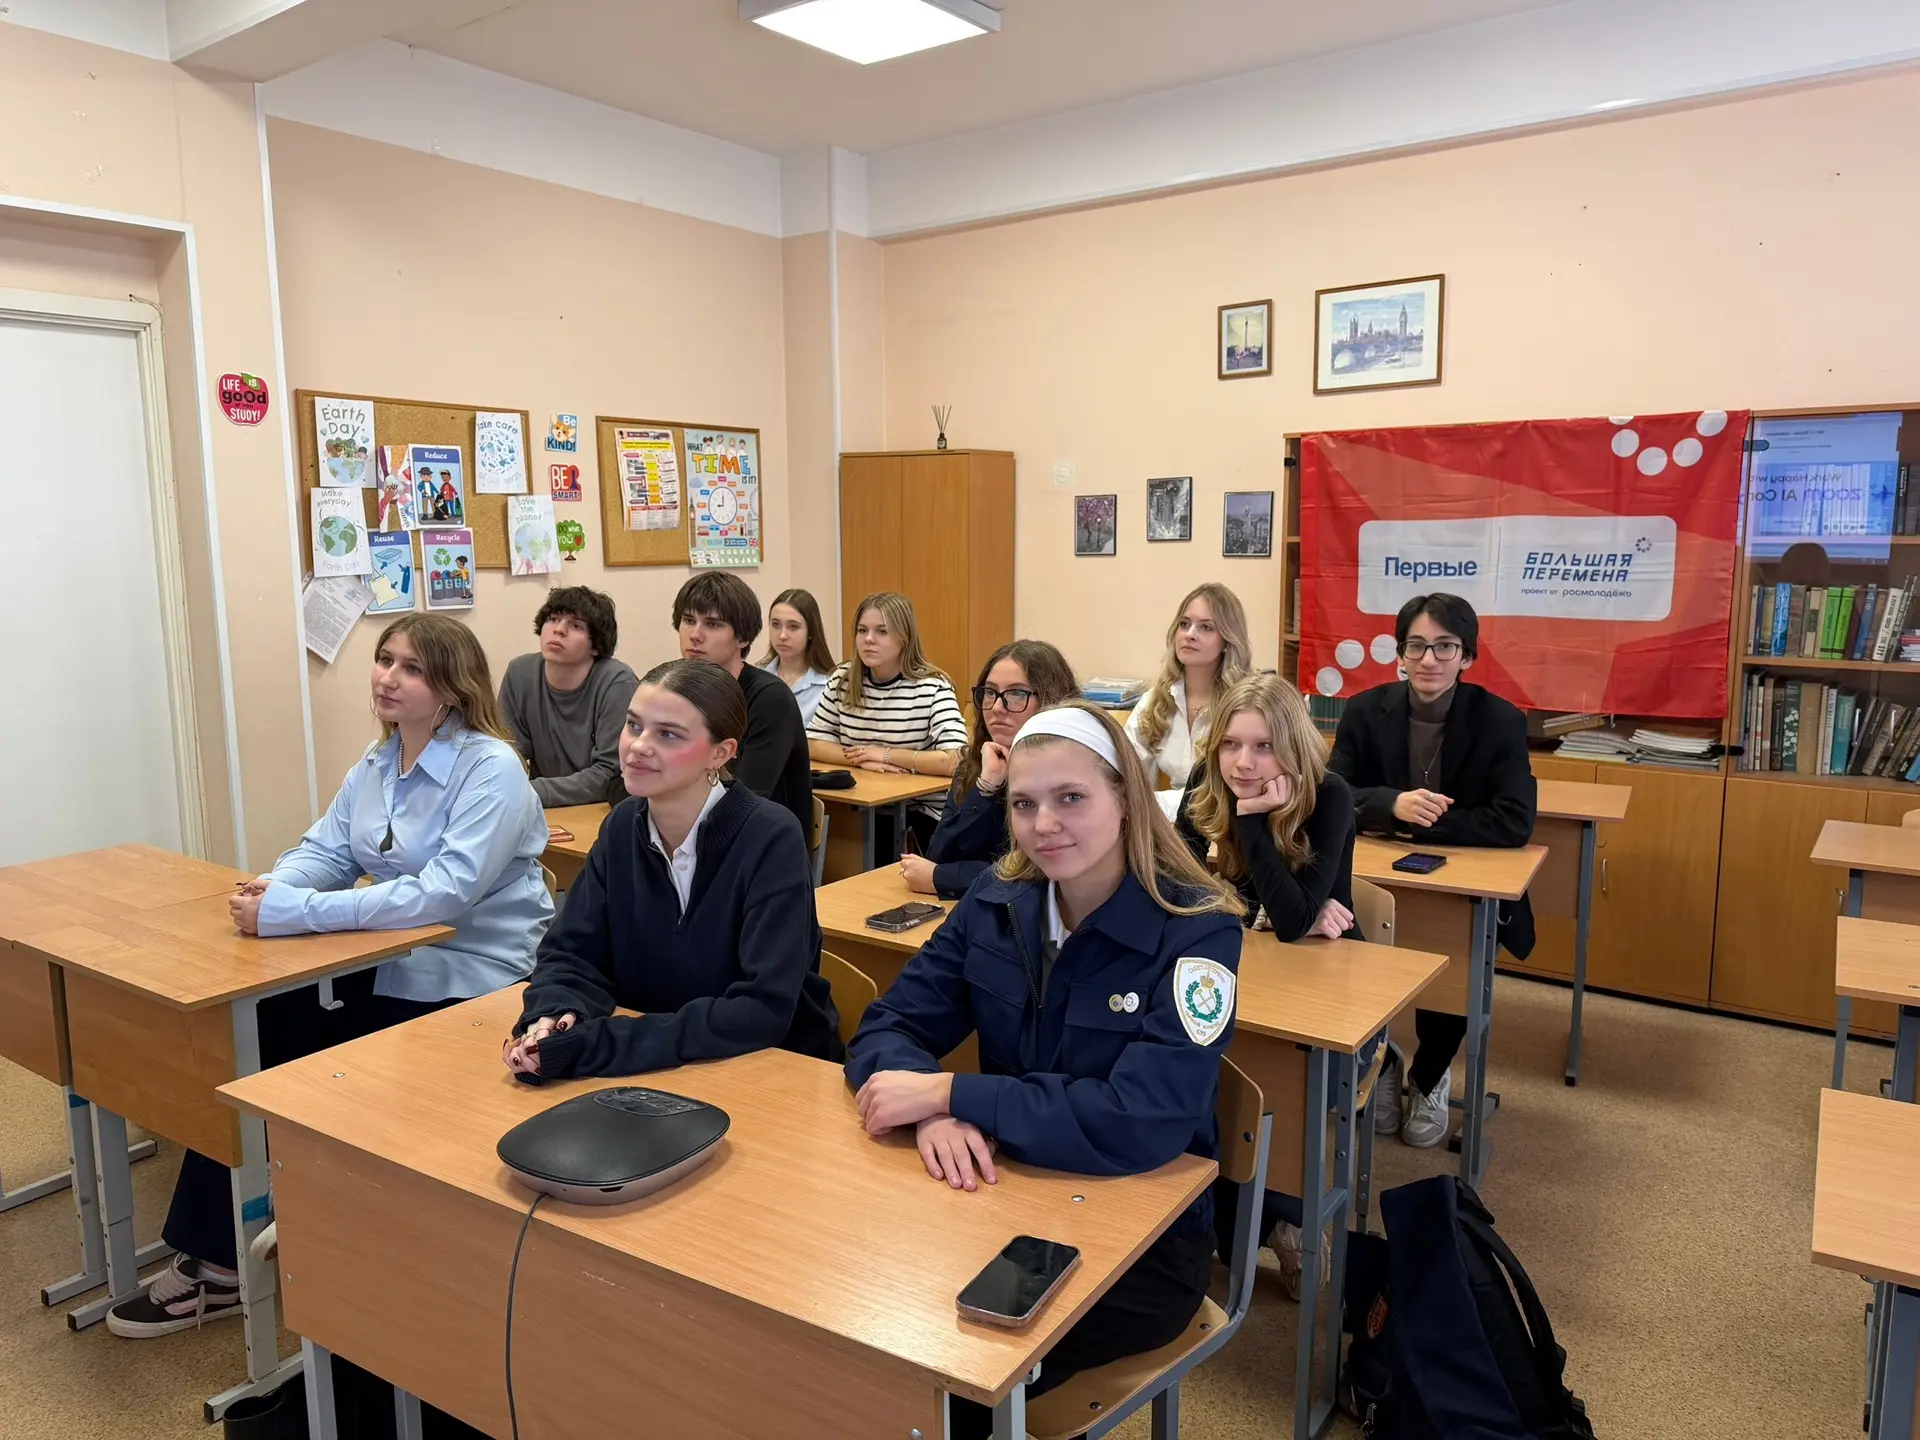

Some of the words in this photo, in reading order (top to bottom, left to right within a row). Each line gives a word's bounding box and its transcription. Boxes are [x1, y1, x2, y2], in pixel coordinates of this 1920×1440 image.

[222, 378, 240, 391] LIFE
[248, 379, 257, 387] IS
[230, 408, 260, 421] STUDY!
[321, 404, 366, 424] Earth
[563, 415, 577, 426] Be
[328, 422, 361, 438] Day
[495, 421, 519, 435] care
[547, 436, 577, 452] KIND!
[687, 442, 703, 452] WHAT
[424, 451, 448, 460] Reduce
[691, 452, 751, 475] TIME
[551, 465, 569, 490] BE
[741, 476, 747, 484] IS
[321, 489, 343, 497] Make
[317, 497, 352, 508] everyday
[516, 513, 542, 525] planet
[374, 535, 395, 543] Reuse
[435, 533, 461, 544] Recycle
[1525, 552, 1633, 567] БОЛЬШАЯ
[1384, 556, 1478, 583] Первые
[1522, 567, 1629, 582] ПЕРЕМЕНА
[1521, 588, 1548, 596] проект
